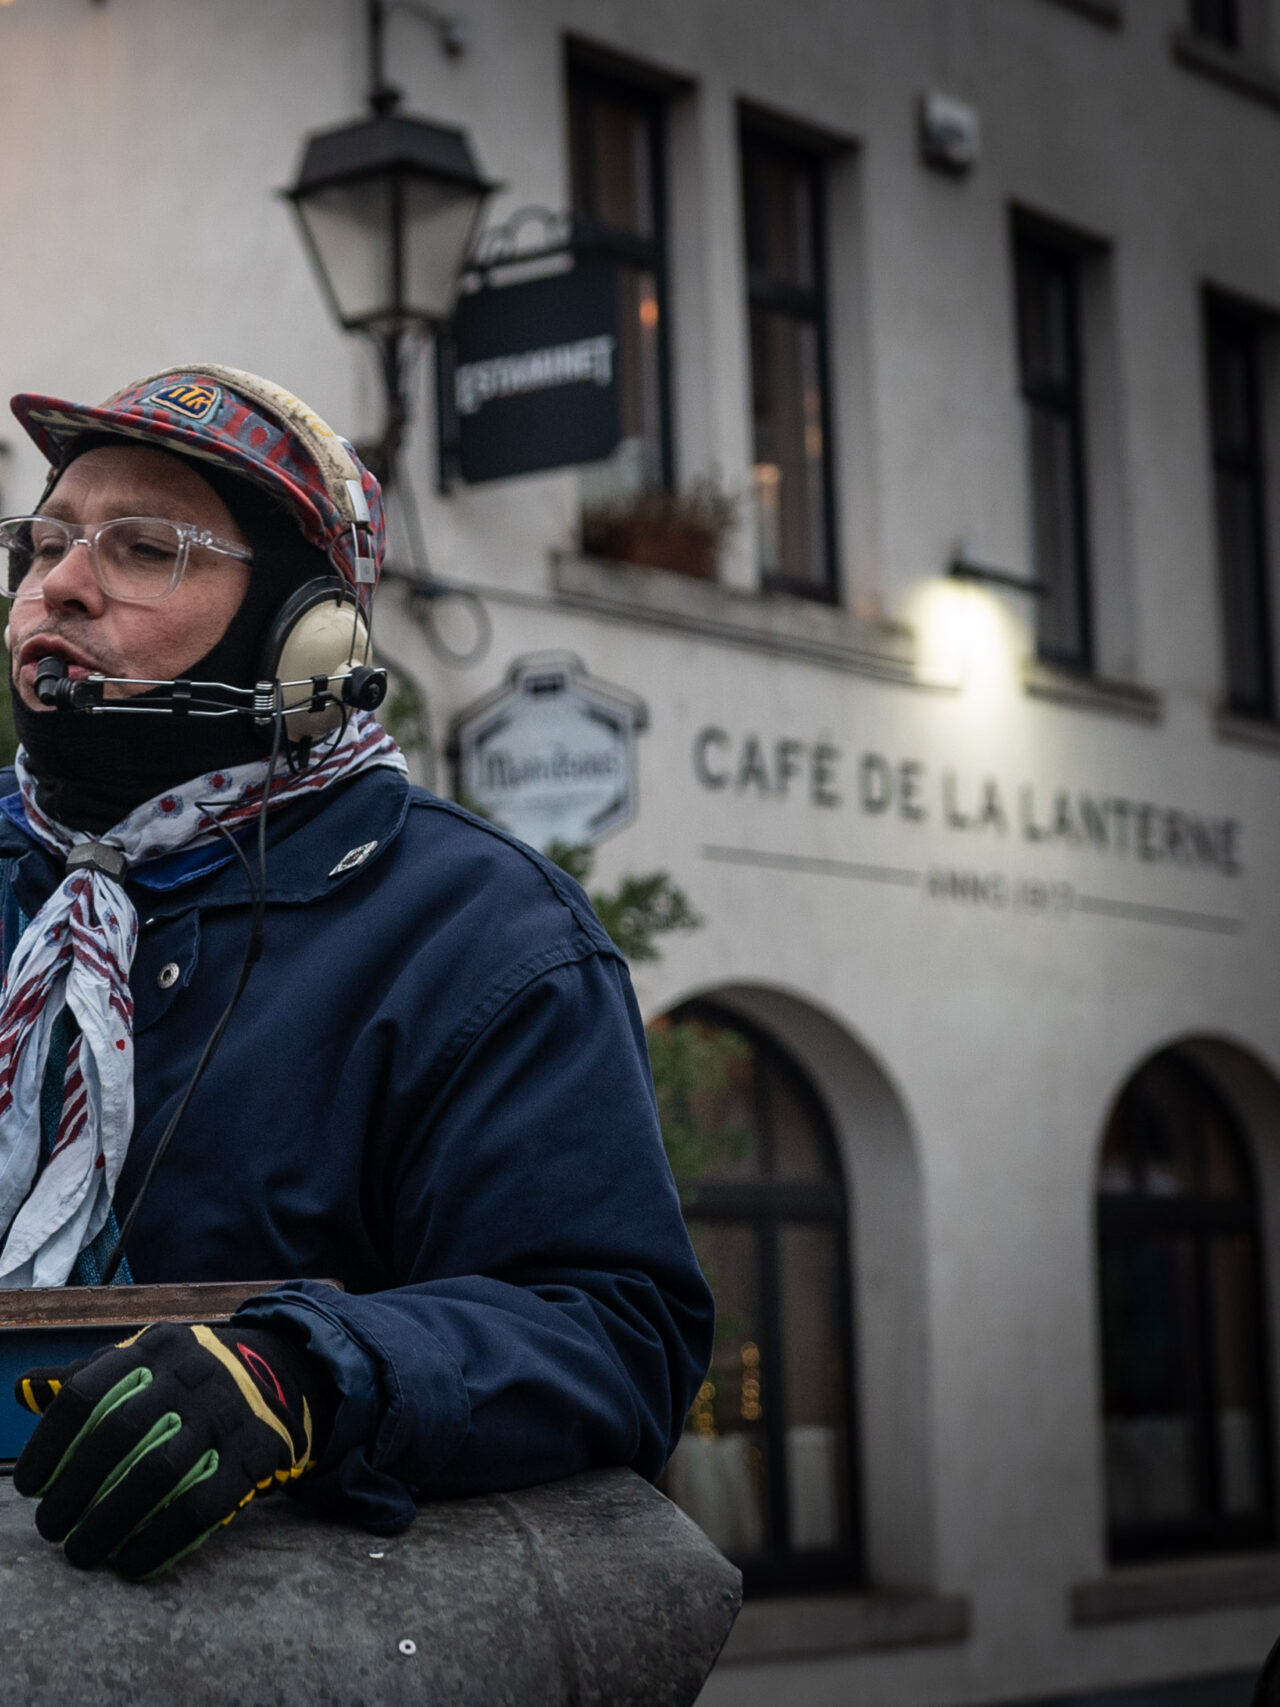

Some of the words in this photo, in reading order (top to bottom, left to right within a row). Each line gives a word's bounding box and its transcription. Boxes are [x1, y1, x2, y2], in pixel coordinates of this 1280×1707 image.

[860, 751, 927, 822] DE
[942, 768, 1009, 839] LA
[1020, 784, 1244, 877] LANTERNE
